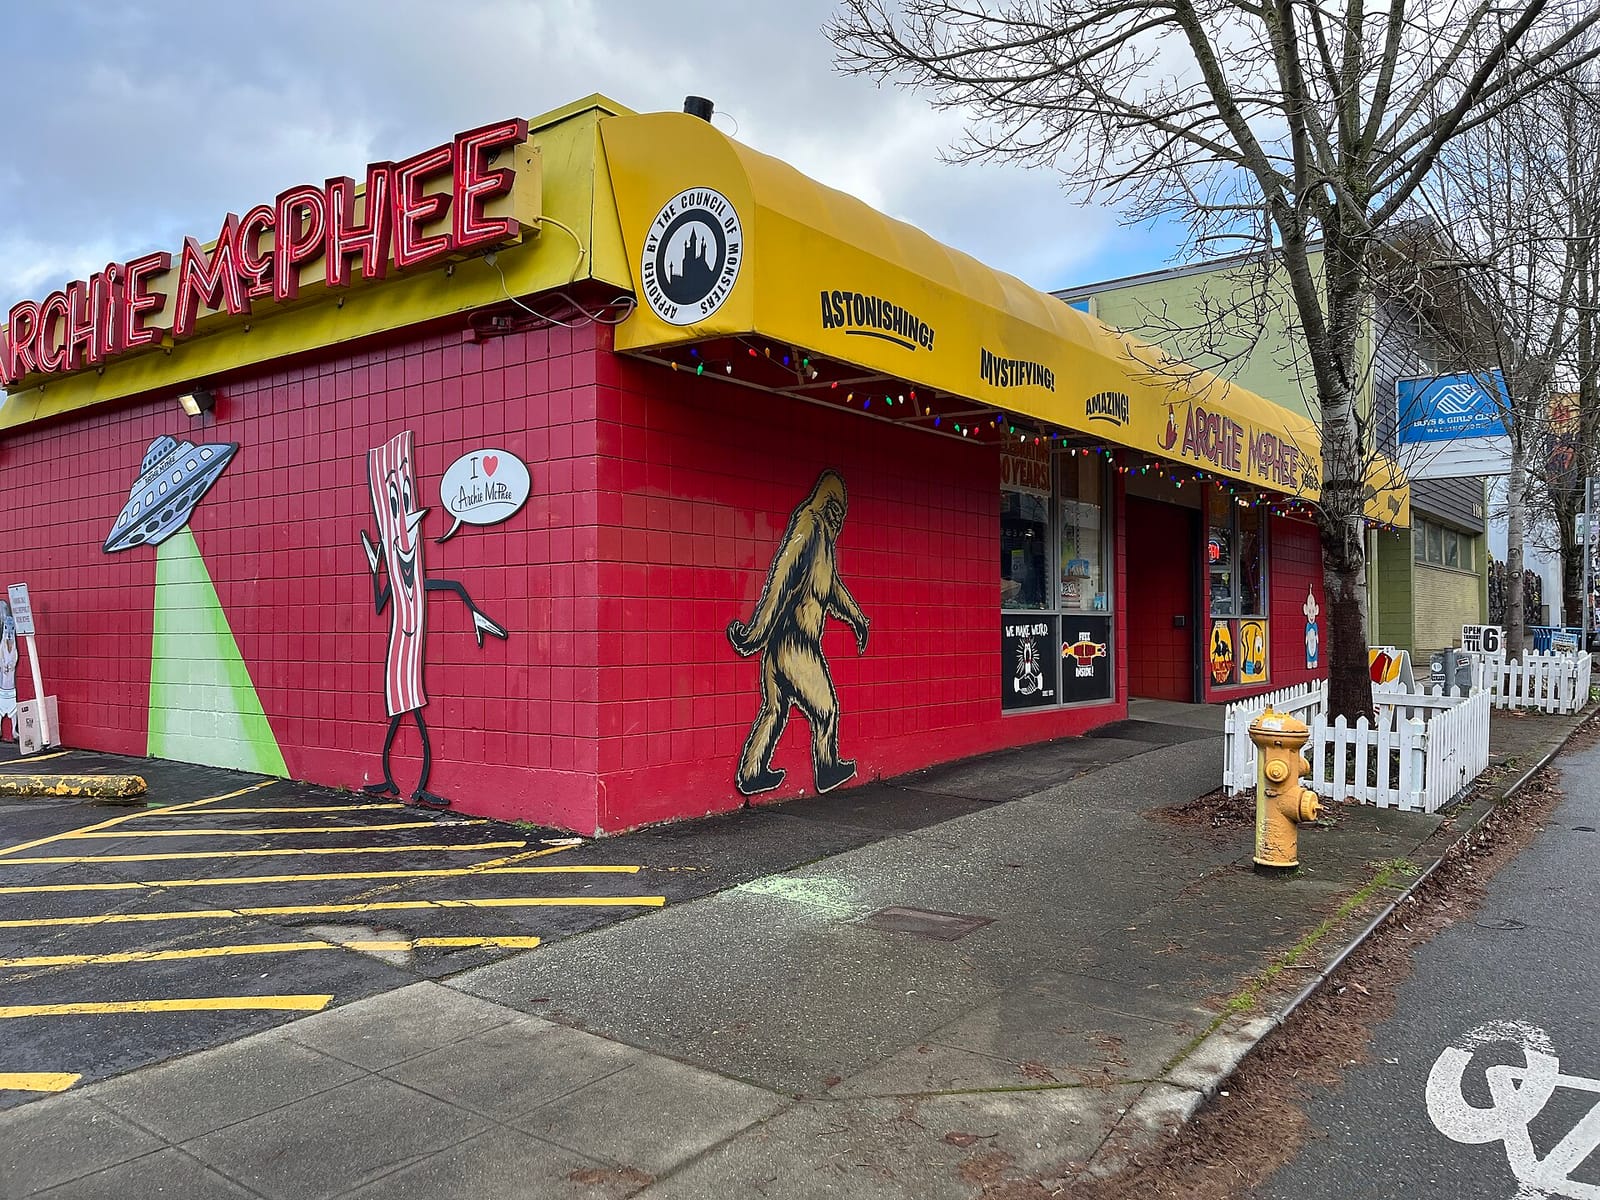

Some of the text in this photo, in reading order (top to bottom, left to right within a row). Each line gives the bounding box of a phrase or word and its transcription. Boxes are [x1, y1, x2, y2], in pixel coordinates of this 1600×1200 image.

[644, 192, 739, 319] APPROVED BY THE COUNCIL OF MONSTERS
[820, 290, 935, 351] ASTONISHING!
[980, 347, 1055, 392] MYSTIFYING!
[1085, 392, 1129, 425] AMAZING!
[1438, 417, 1446, 425] &
[1446, 415, 1473, 424] GIRLS
[1181, 401, 1244, 472] ARCHIE
[470, 457, 479, 480] I
[458, 484, 483, 509] Archie
[1005, 625, 1015, 637] WE
[1015, 624, 1031, 638] MAKE
[1463, 626, 1481, 634] OPEN
[1483, 628, 1498, 652] 6
